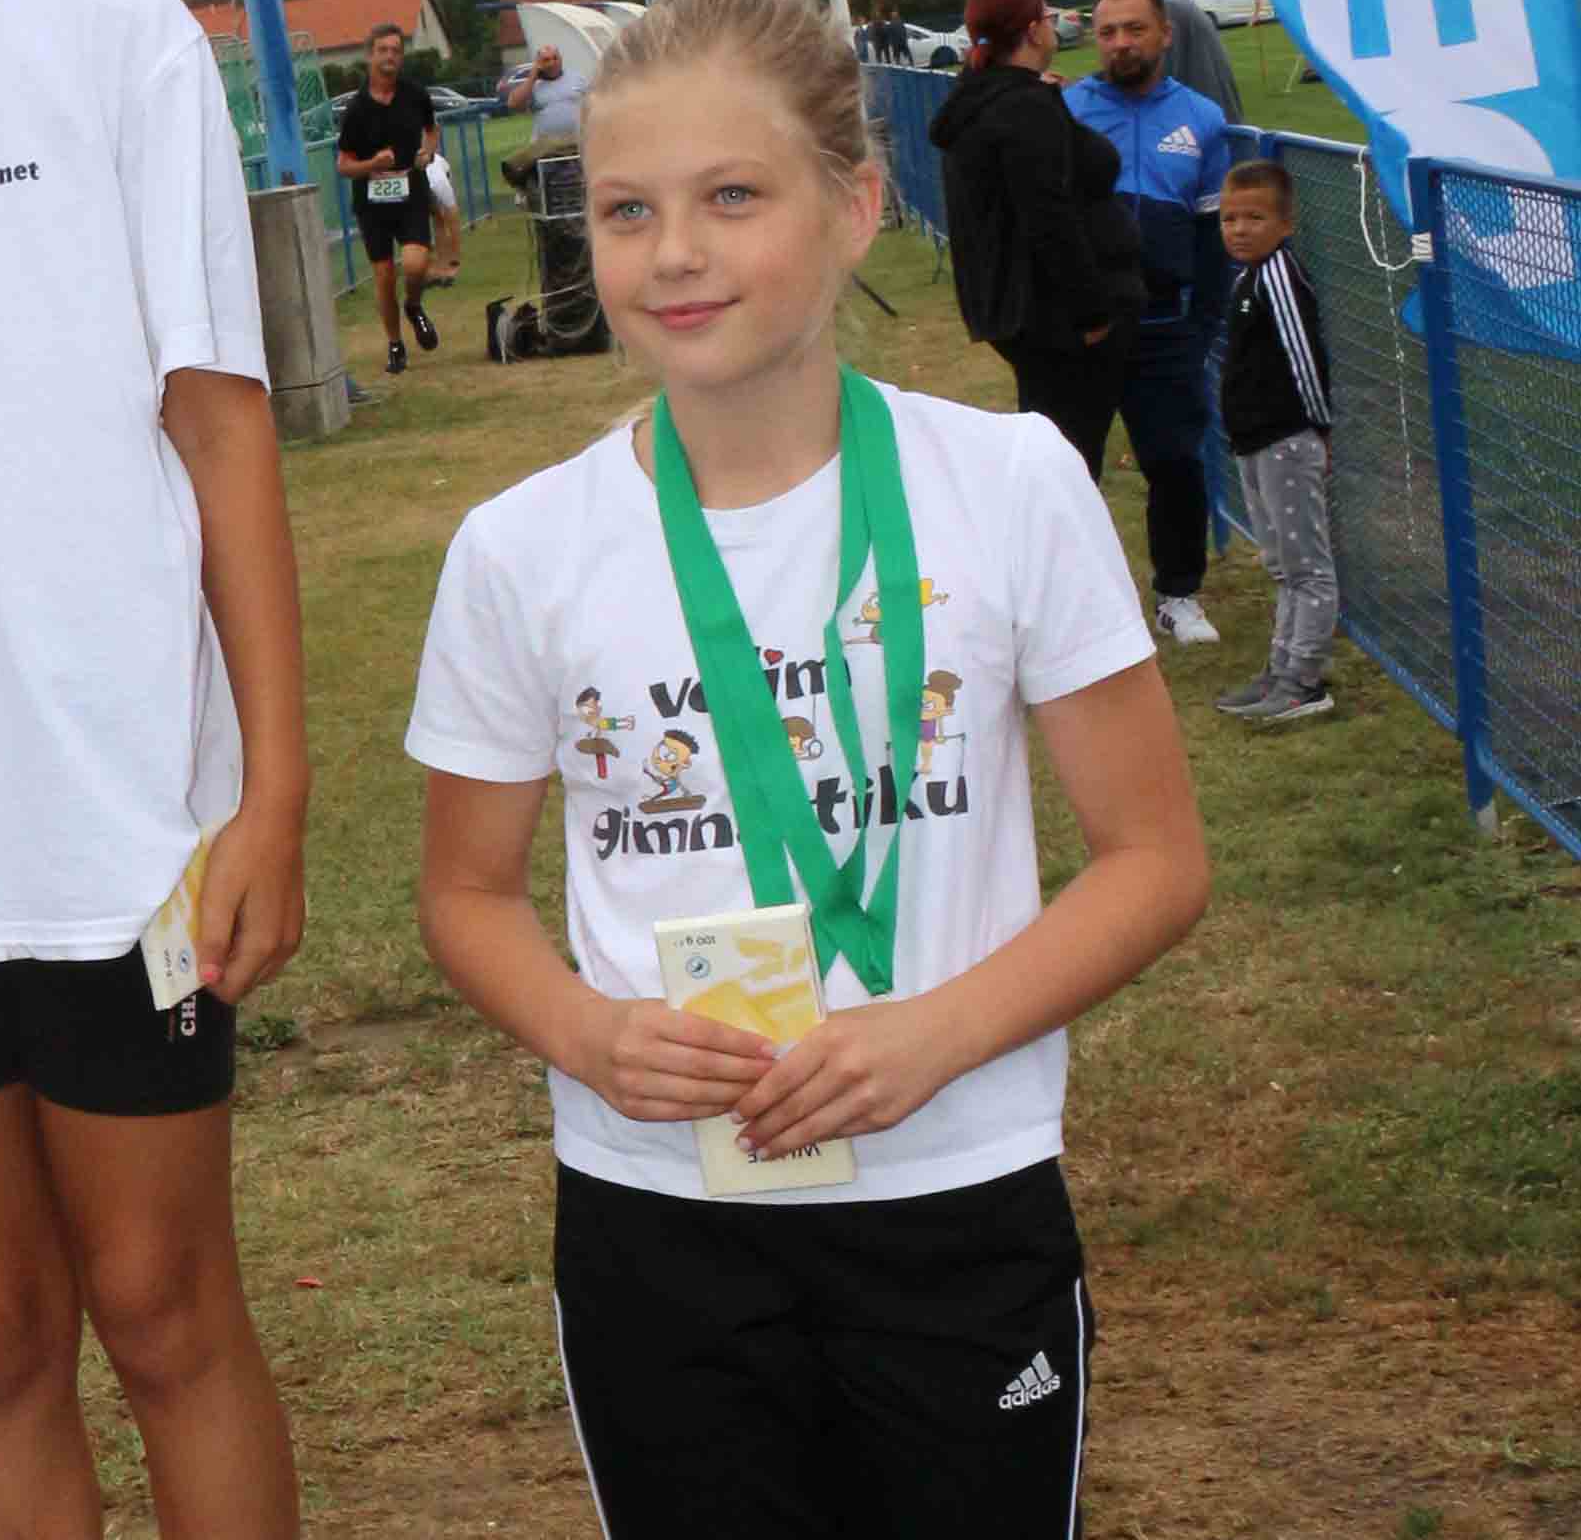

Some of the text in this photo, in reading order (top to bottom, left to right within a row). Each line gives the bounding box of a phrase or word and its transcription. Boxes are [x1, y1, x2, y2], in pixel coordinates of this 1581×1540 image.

[372, 180, 403, 197] 222
[592, 763, 970, 861] gimntiku
[998, 1374, 1061, 1410] adidas
